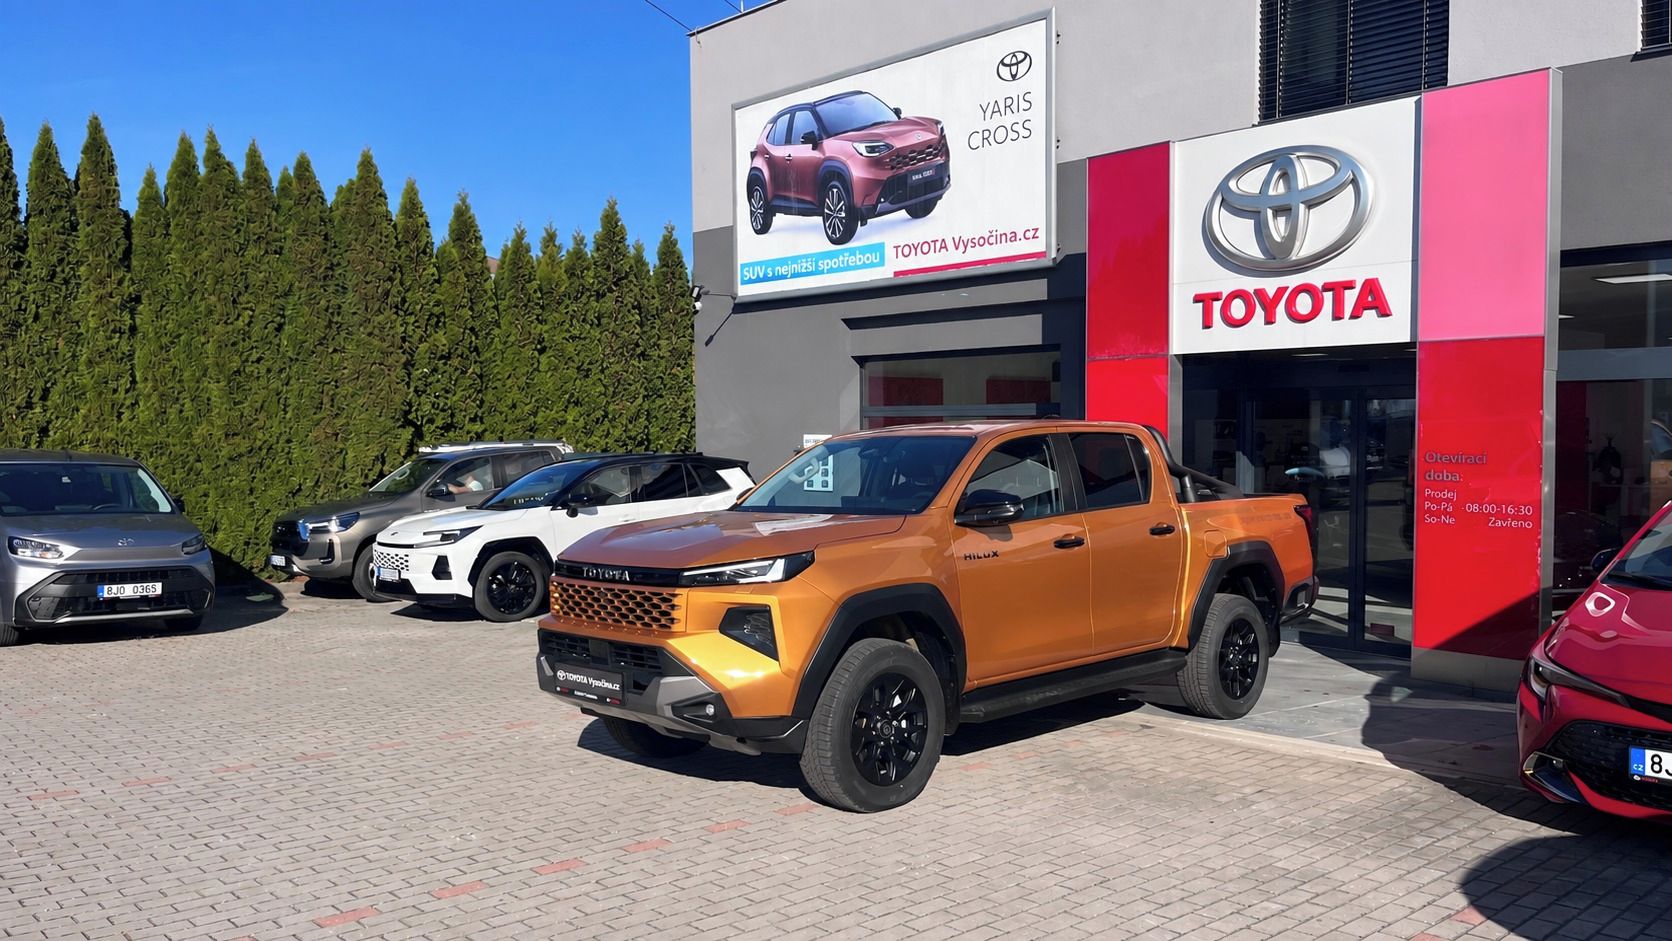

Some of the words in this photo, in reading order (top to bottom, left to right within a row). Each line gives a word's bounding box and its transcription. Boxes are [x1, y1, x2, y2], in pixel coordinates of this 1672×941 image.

[979, 91, 1032, 121] YARIS
[968, 119, 1032, 150] CROSS
[893, 238, 949, 259] TOYOTA
[952, 227, 1040, 254] Vysočina.cz
[743, 265, 766, 280] SUV
[767, 267, 773, 277] s
[775, 258, 816, 278] nejnižší
[818, 251, 880, 273] spotřebou
[1193, 277, 1393, 330] TOYOTA
[1424, 488, 1457, 501] Prodej
[1424, 502, 1453, 512] Po-Pá
[1424, 515, 1456, 525] So-Ne
[1488, 516, 1533, 529] Zavřeno
[582, 566, 630, 581] TOYOTA
[565, 672, 588, 684] TOYOTA
